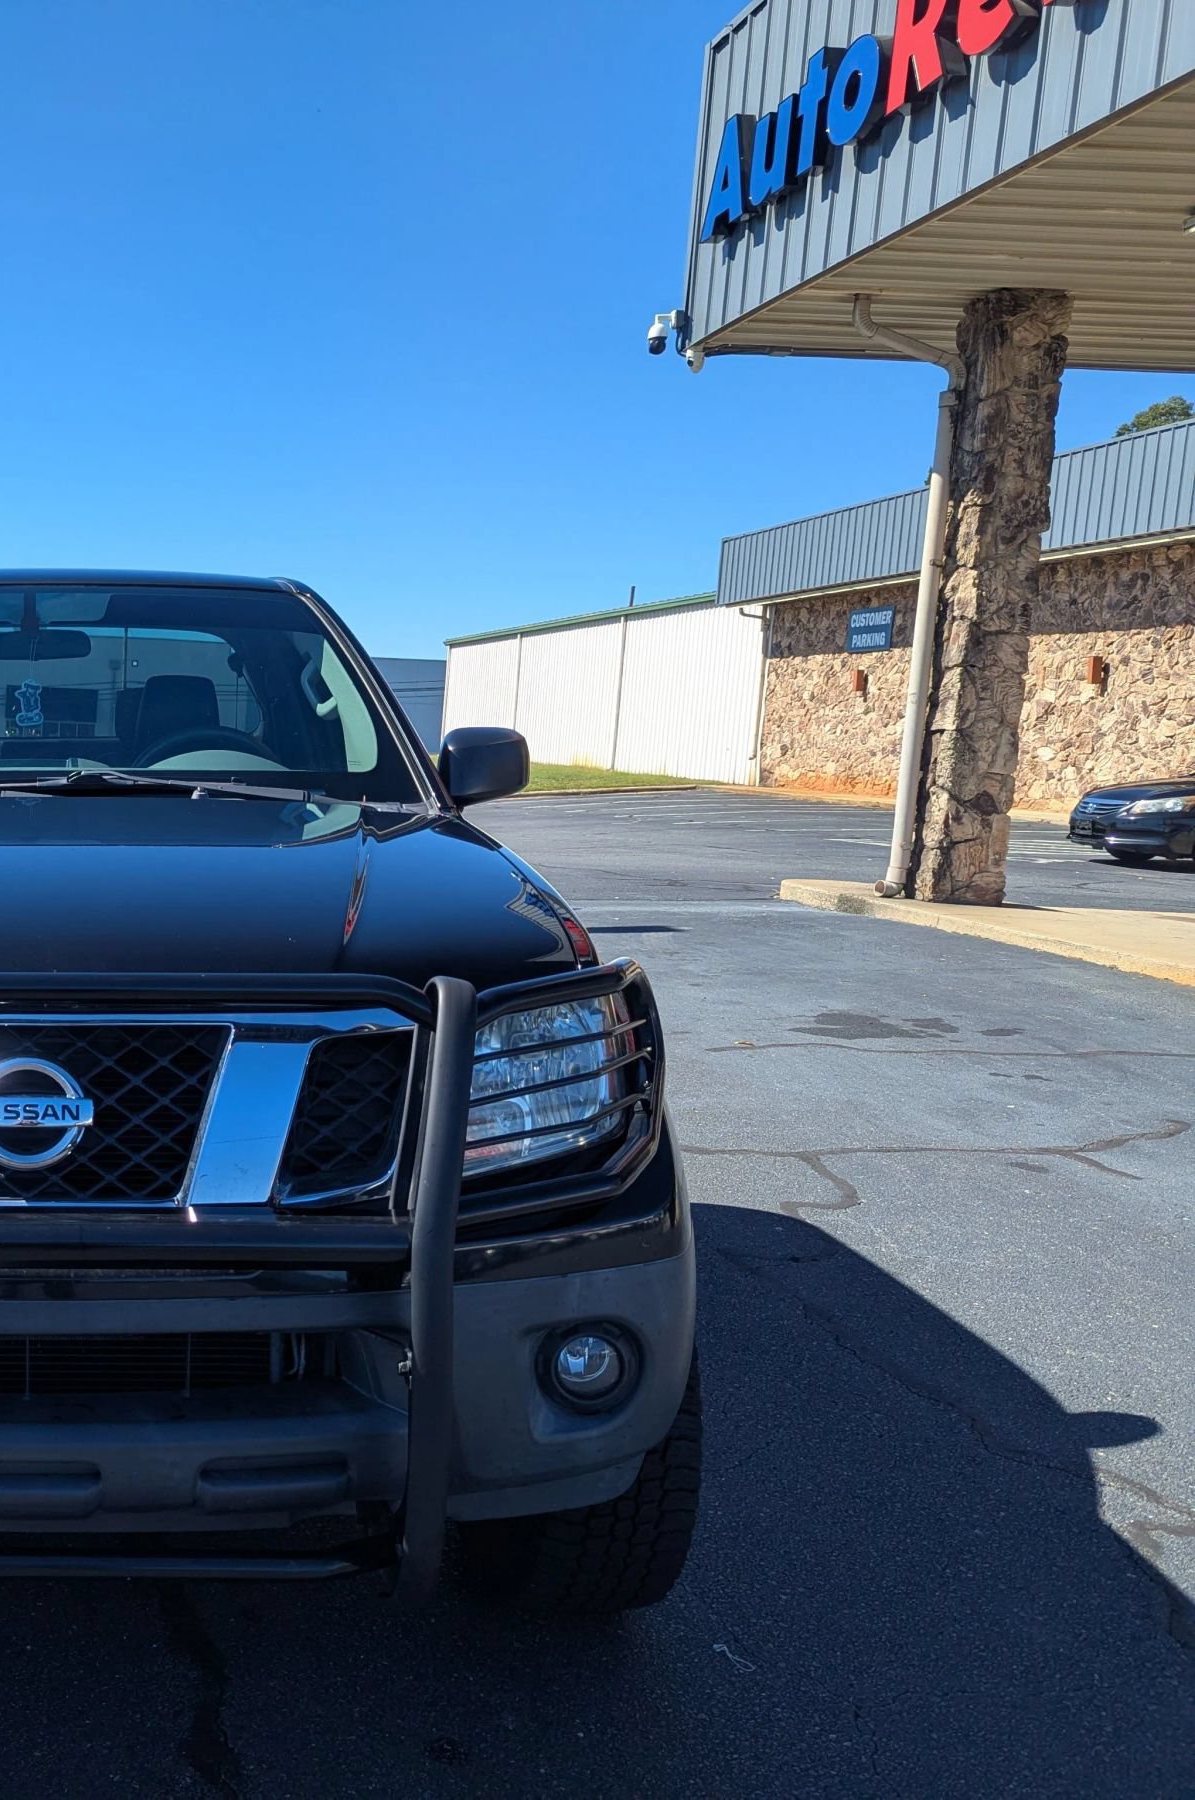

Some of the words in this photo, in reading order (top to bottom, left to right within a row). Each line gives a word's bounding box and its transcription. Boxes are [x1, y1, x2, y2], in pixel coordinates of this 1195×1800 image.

[701, 0, 1053, 242] AutoR
[850, 610, 892, 627] CUSTOMER
[851, 632, 885, 647] PARKING
